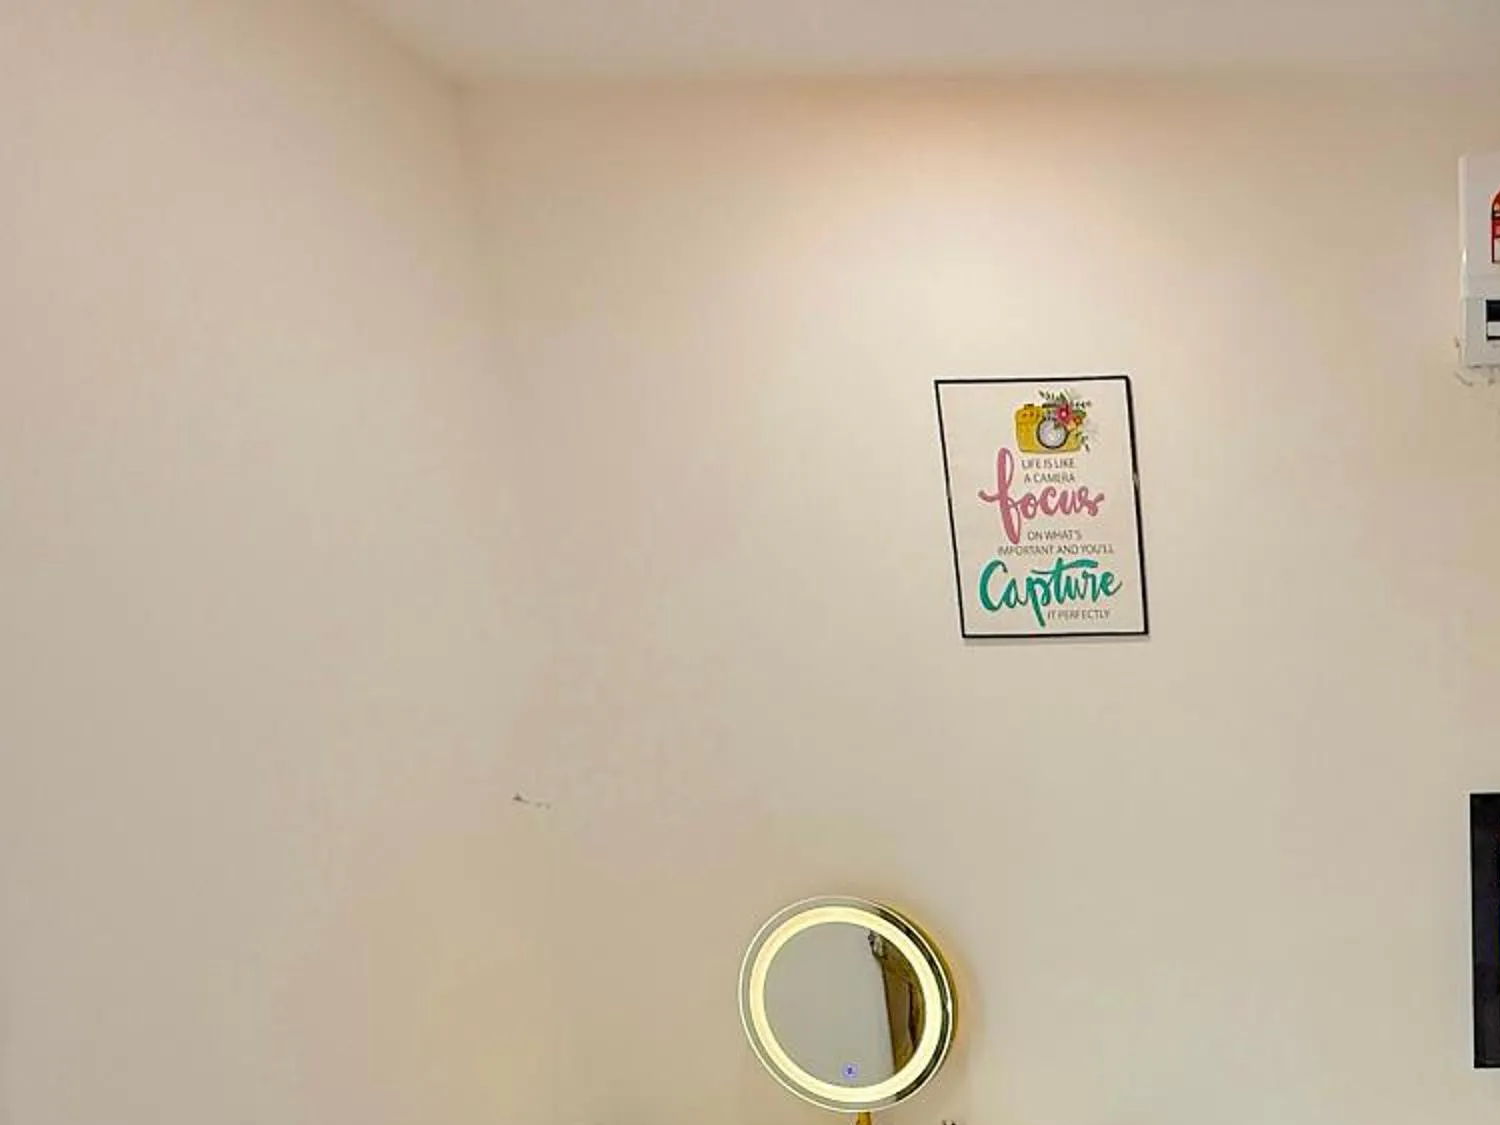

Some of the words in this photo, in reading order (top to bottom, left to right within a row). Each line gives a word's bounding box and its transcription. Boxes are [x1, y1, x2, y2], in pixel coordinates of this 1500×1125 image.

[1021, 458, 1042, 469] LIFE
[1043, 458, 1053, 468] IS
[1055, 458, 1076, 468] LIKE
[1024, 473, 1031, 484] A
[1033, 472, 1076, 483] CAMERA
[978, 448, 1104, 544] focus
[1027, 530, 1043, 541] ON
[1045, 529, 1082, 540] WHAT'S
[997, 545, 1055, 556] IMPORTANT
[1057, 544, 1078, 555] AND
[979, 557, 1123, 627] Capture
[1047, 610, 1057, 620] IT
[1058, 609, 1111, 620] PERFECTLY
